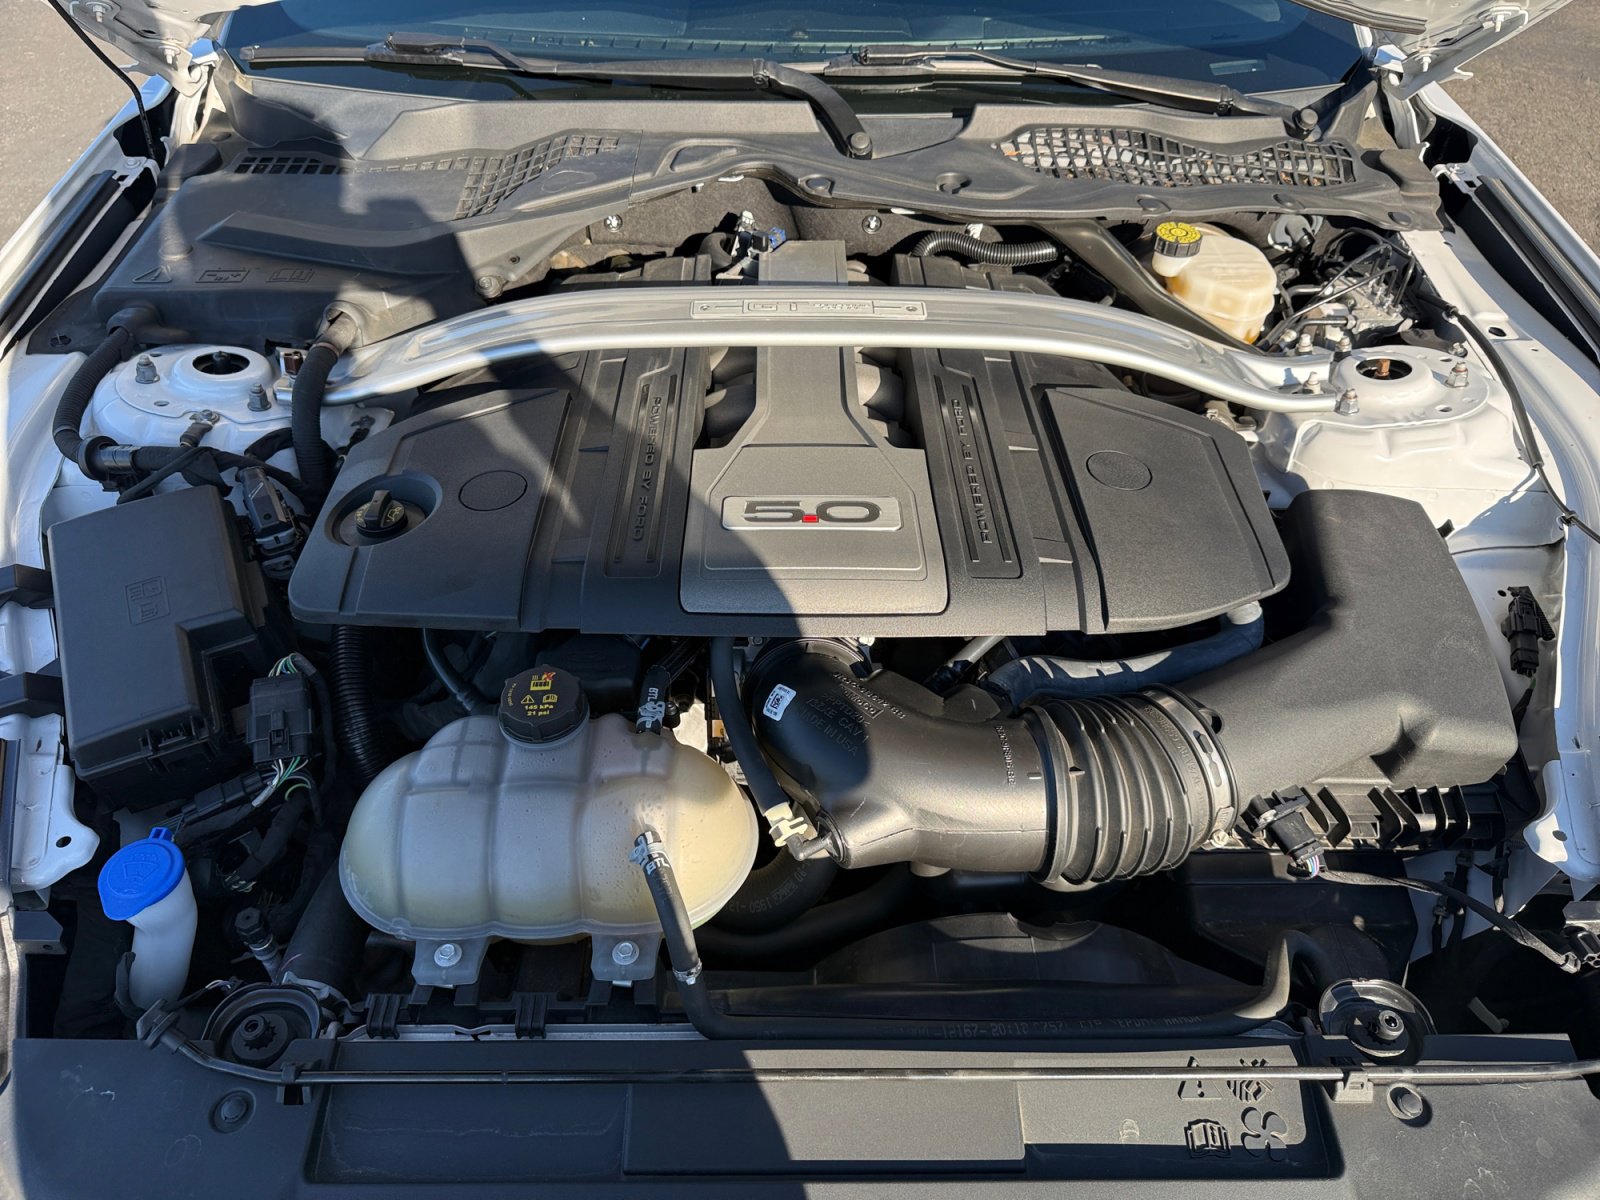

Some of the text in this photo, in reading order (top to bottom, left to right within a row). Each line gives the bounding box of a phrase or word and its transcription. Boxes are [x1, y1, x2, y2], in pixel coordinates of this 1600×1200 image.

[633, 397, 662, 541] POWERED BY FORD
[951, 399, 993, 543] POWERED BY FORD
[742, 500, 881, 523] 5.0
[647, 687, 659, 702] BTL
[822, 723, 839, 739] IN
[835, 733, 861, 757] USA
[647, 857, 669, 874] BTL
